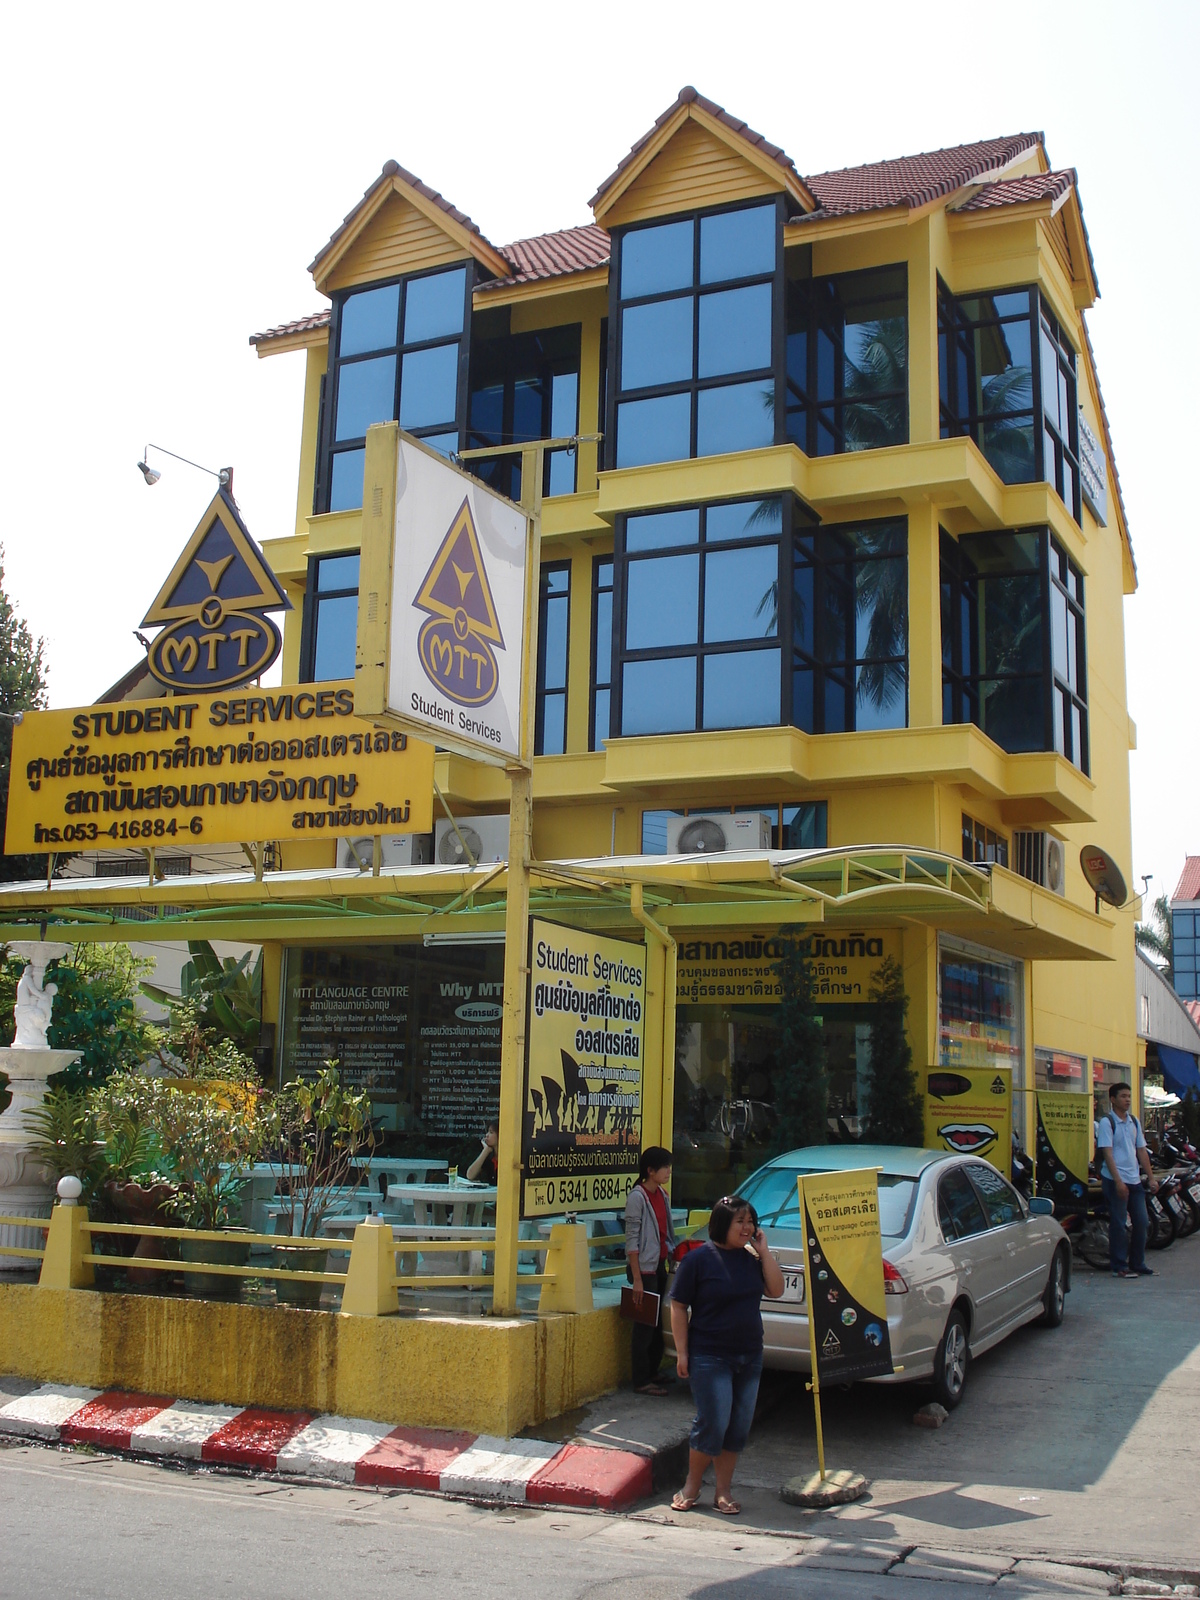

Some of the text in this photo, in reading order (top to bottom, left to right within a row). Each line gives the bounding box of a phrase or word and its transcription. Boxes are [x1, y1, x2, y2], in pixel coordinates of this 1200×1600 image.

[161, 630, 258, 674] MTT
[429, 633, 488, 690] MTT
[71, 688, 353, 738] STUDENT SERVICES
[411, 693, 502, 743] Student Services
[26, 725, 408, 791] ศูนย์ข้อมูลการศึกษาต่อออสเตรเลย
[64, 771, 358, 815] สถาบันสอนภาษาอังกฤษ
[292, 800, 410, 829] สาขาเชียงใหม่
[536, 941, 642, 987] Student Services
[293, 986, 409, 998] MTT LANGUAGE CENTRE
[440, 983, 473, 1000] Why
[325, 1014, 347, 1023] Stephen
[375, 1013, 407, 1023] Pathologist
[576, 1028, 640, 1058] ออสเตรเลีย
[621, 1128, 627, 1145] 1
[546, 1180, 555, 1205] 0
[558, 1179, 588, 1204] 5341
[816, 1199, 877, 1219] ออสเตรเลีย
[818, 1220, 878, 1233] MTT Language Centre
